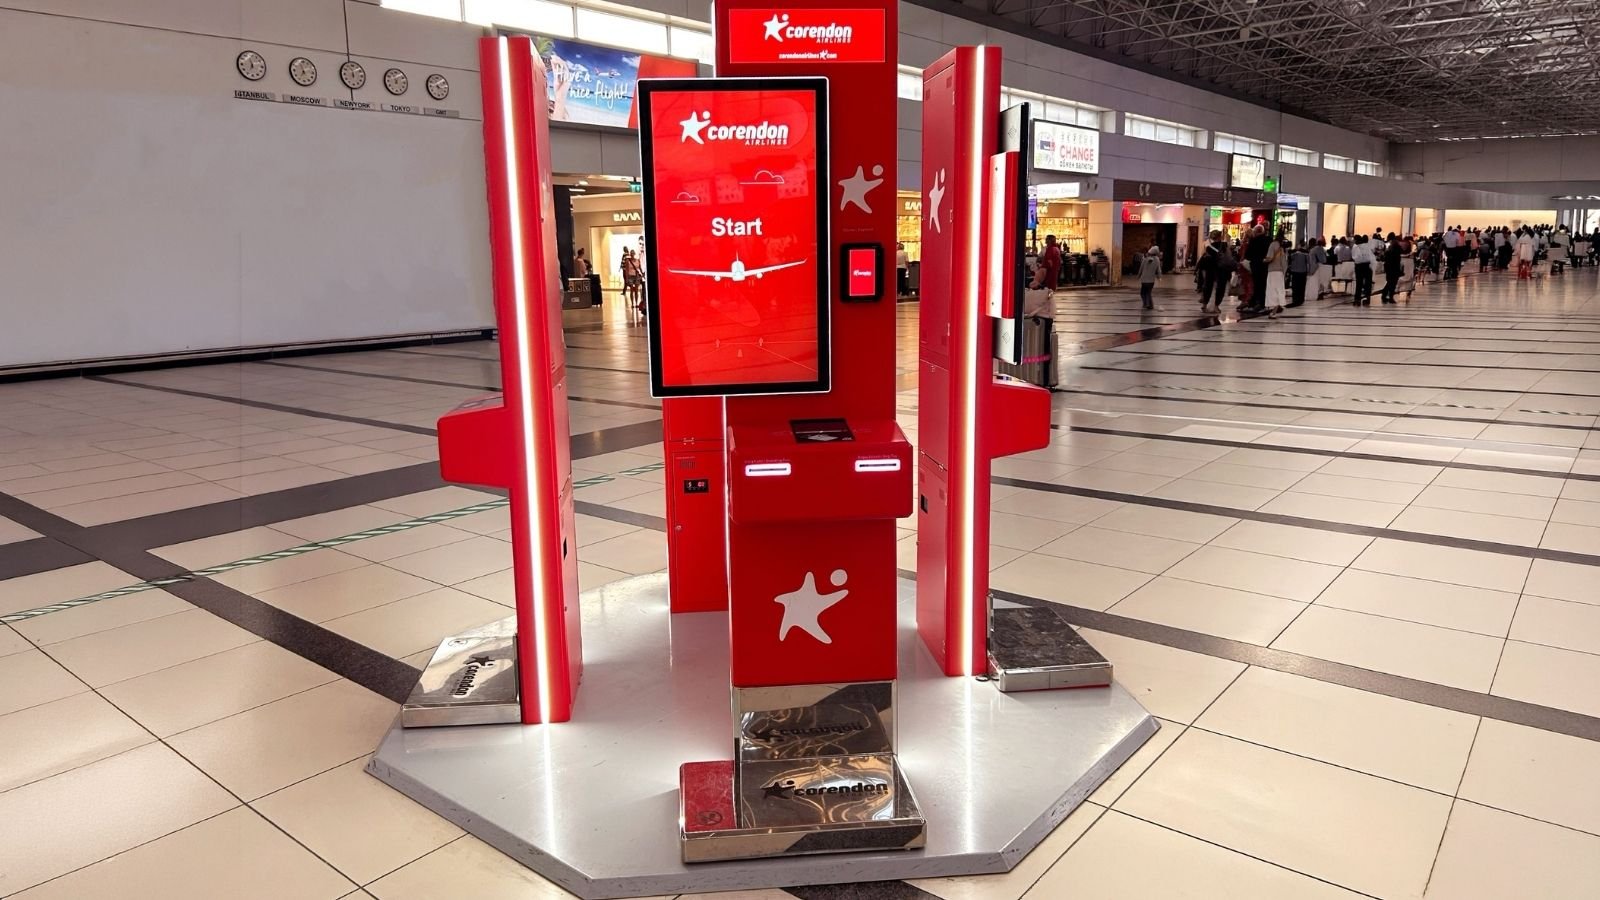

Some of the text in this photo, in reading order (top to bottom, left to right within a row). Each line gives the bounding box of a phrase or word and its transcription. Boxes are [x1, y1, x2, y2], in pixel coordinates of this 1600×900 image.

[785, 22, 853, 39] corendon
[553, 64, 593, 83] Have a
[290, 95, 321, 104] MOSCOW
[569, 80, 628, 109] nice flight!
[391, 104, 411, 113] TOKYO
[707, 121, 789, 140] corendon
[1059, 145, 1094, 162] CHANGE
[711, 216, 763, 237] Start
[455, 665, 481, 696] corendon
[794, 782, 888, 796] corendon
